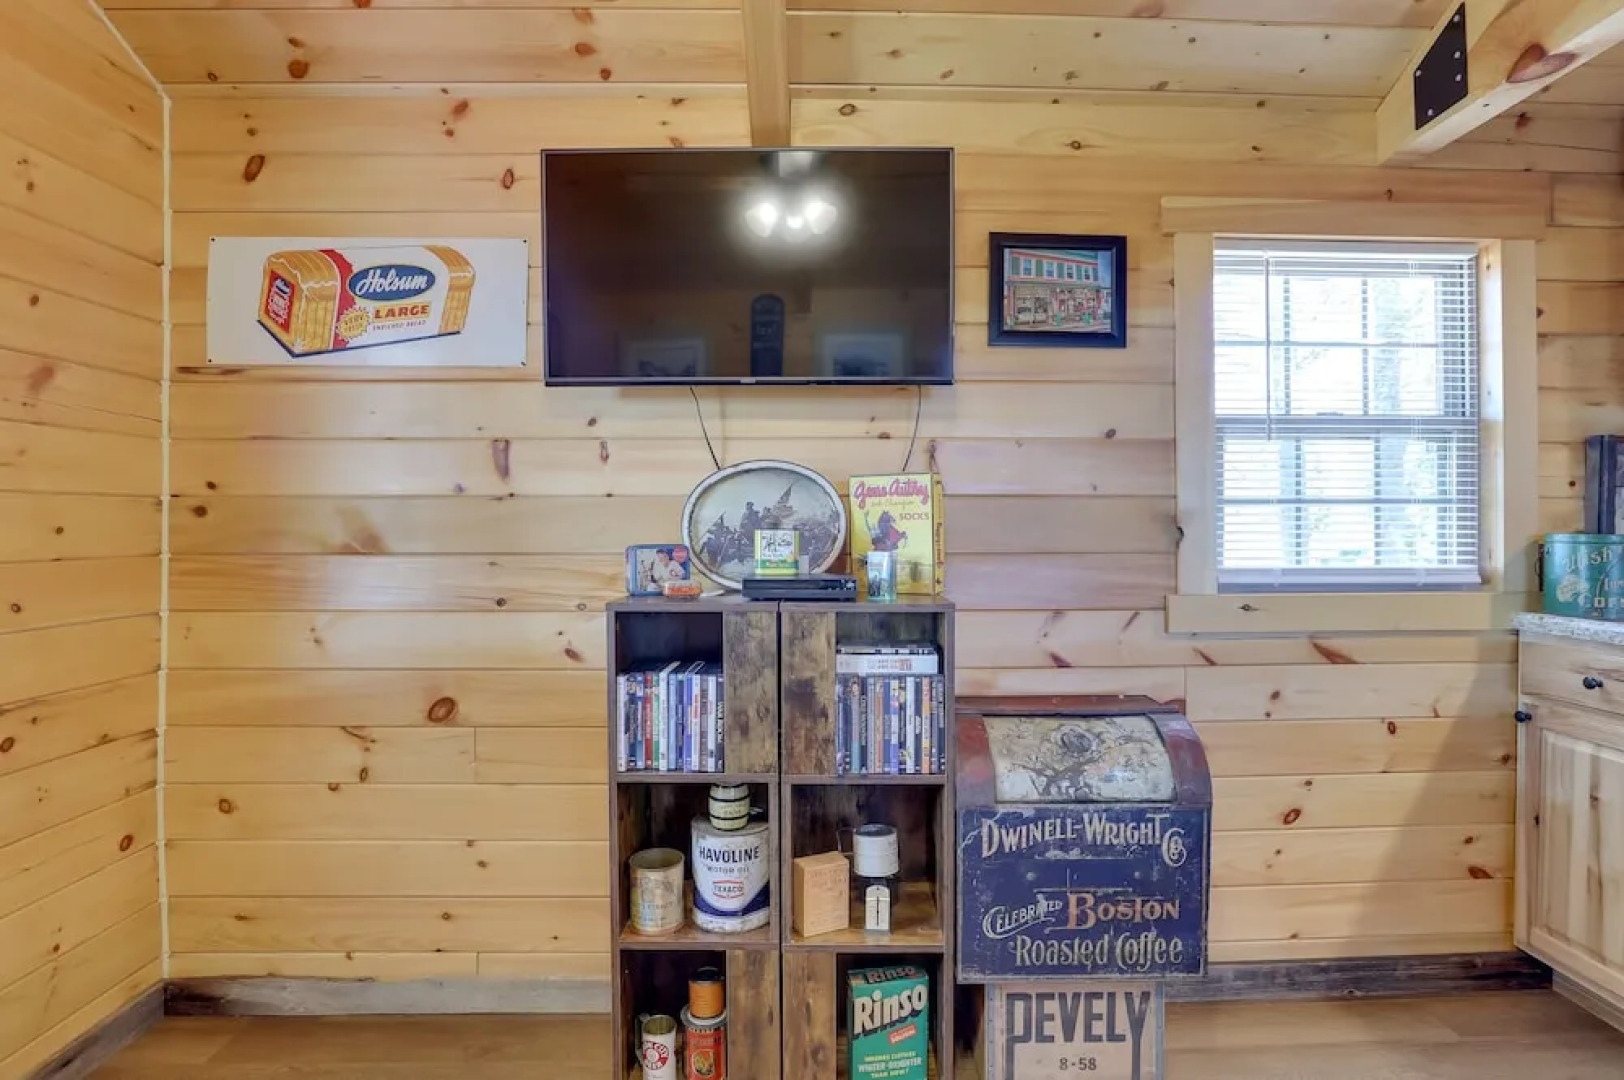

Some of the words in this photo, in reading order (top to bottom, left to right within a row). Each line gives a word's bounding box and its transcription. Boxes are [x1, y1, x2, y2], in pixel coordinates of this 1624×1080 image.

[355, 268, 428, 295] Holsum
[374, 304, 430, 319] LARGE
[899, 512, 930, 521] SOCKS
[981, 812, 1170, 858] DWINELL-WRIGHT
[699, 845, 759, 863] HAVOLINE
[1066, 892, 1180, 929] BOSTON
[1014, 933, 1109, 967] Roasted
[1116, 931, 1183, 971] Coffee
[866, 967, 916, 984] Rinso
[852, 984, 928, 1036] Rinso
[1059, 1057, 1097, 1071] 8-58
